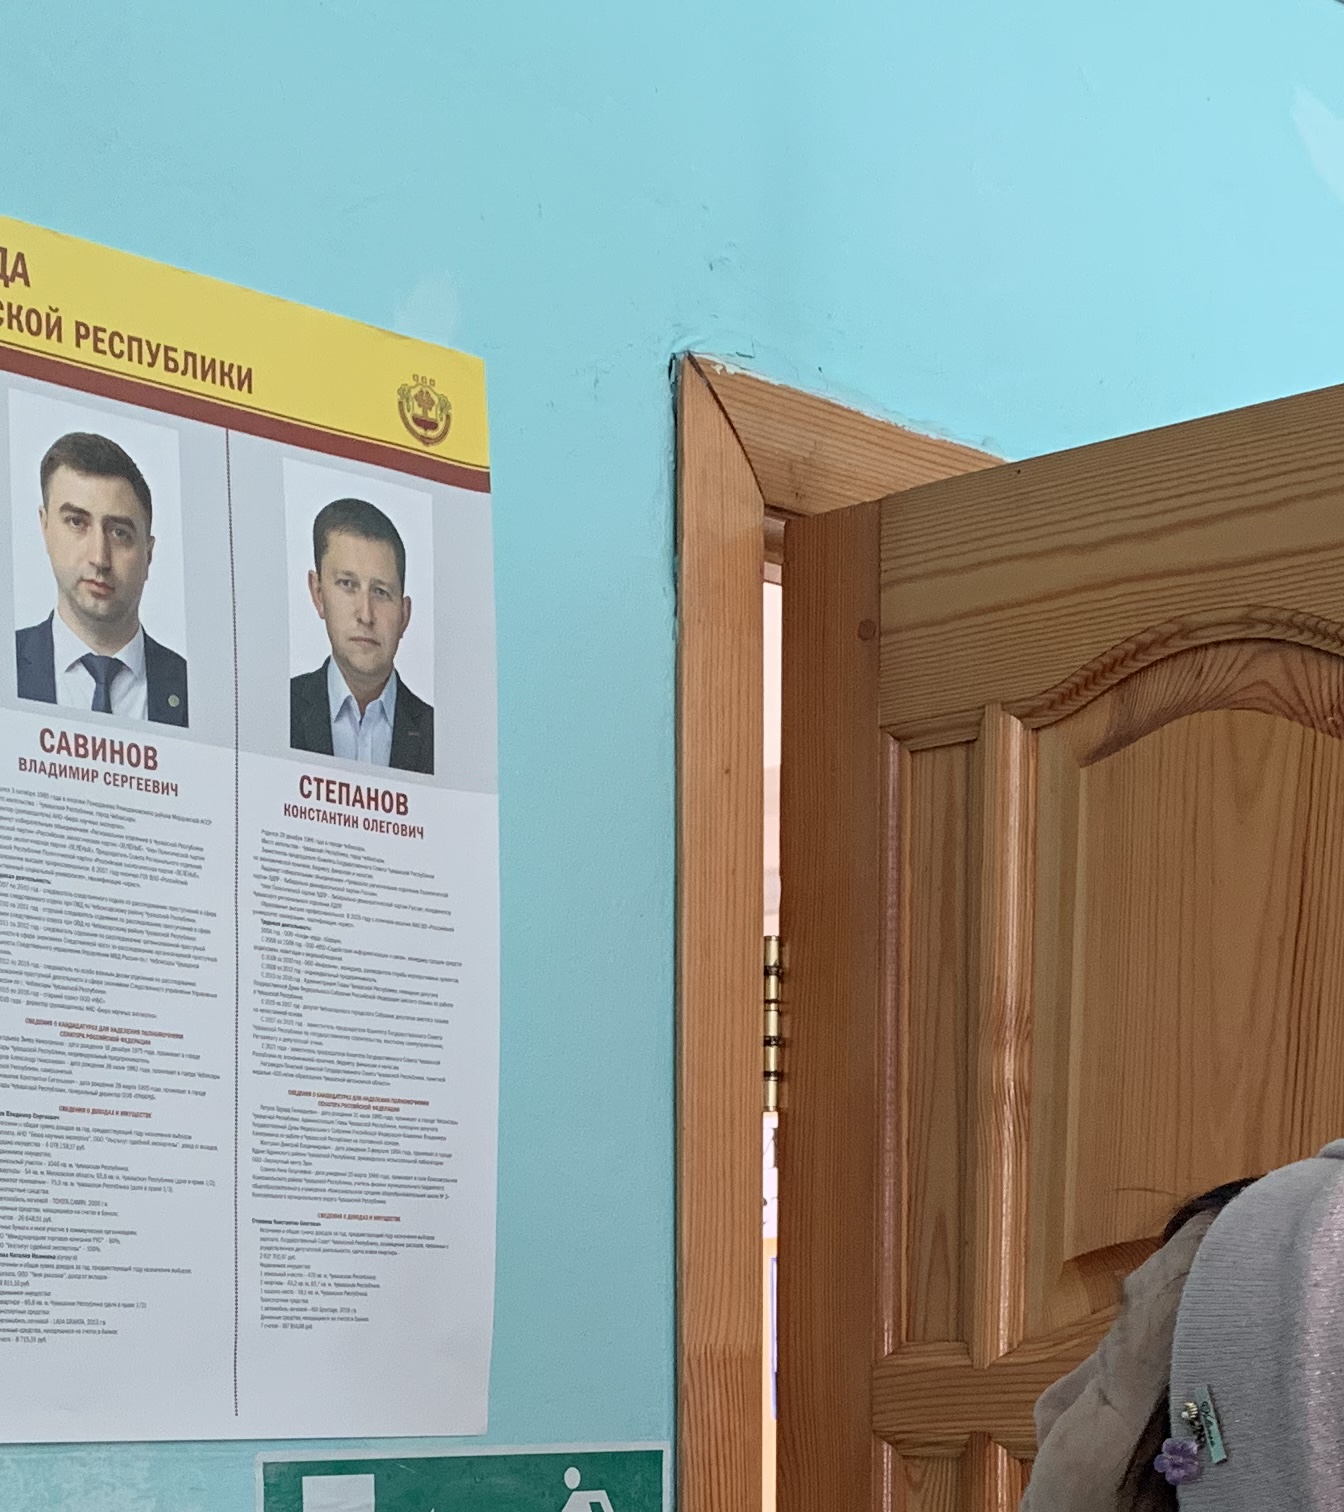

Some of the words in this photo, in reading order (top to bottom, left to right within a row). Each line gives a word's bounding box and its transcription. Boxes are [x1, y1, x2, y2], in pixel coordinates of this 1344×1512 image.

[75, 321, 254, 394] РЕСПУБЛИКИ
[39, 727, 158, 771] САВИНОВ
[18, 757, 99, 783] ВЛАДИМИР
[103, 771, 179, 797] СЕРГЕЕВИЧ
[299, 774, 409, 816] СТЕПАНОВ
[283, 803, 359, 829] КОНСТАНТИН
[362, 817, 424, 840] ОЛЕГОВИЧ
